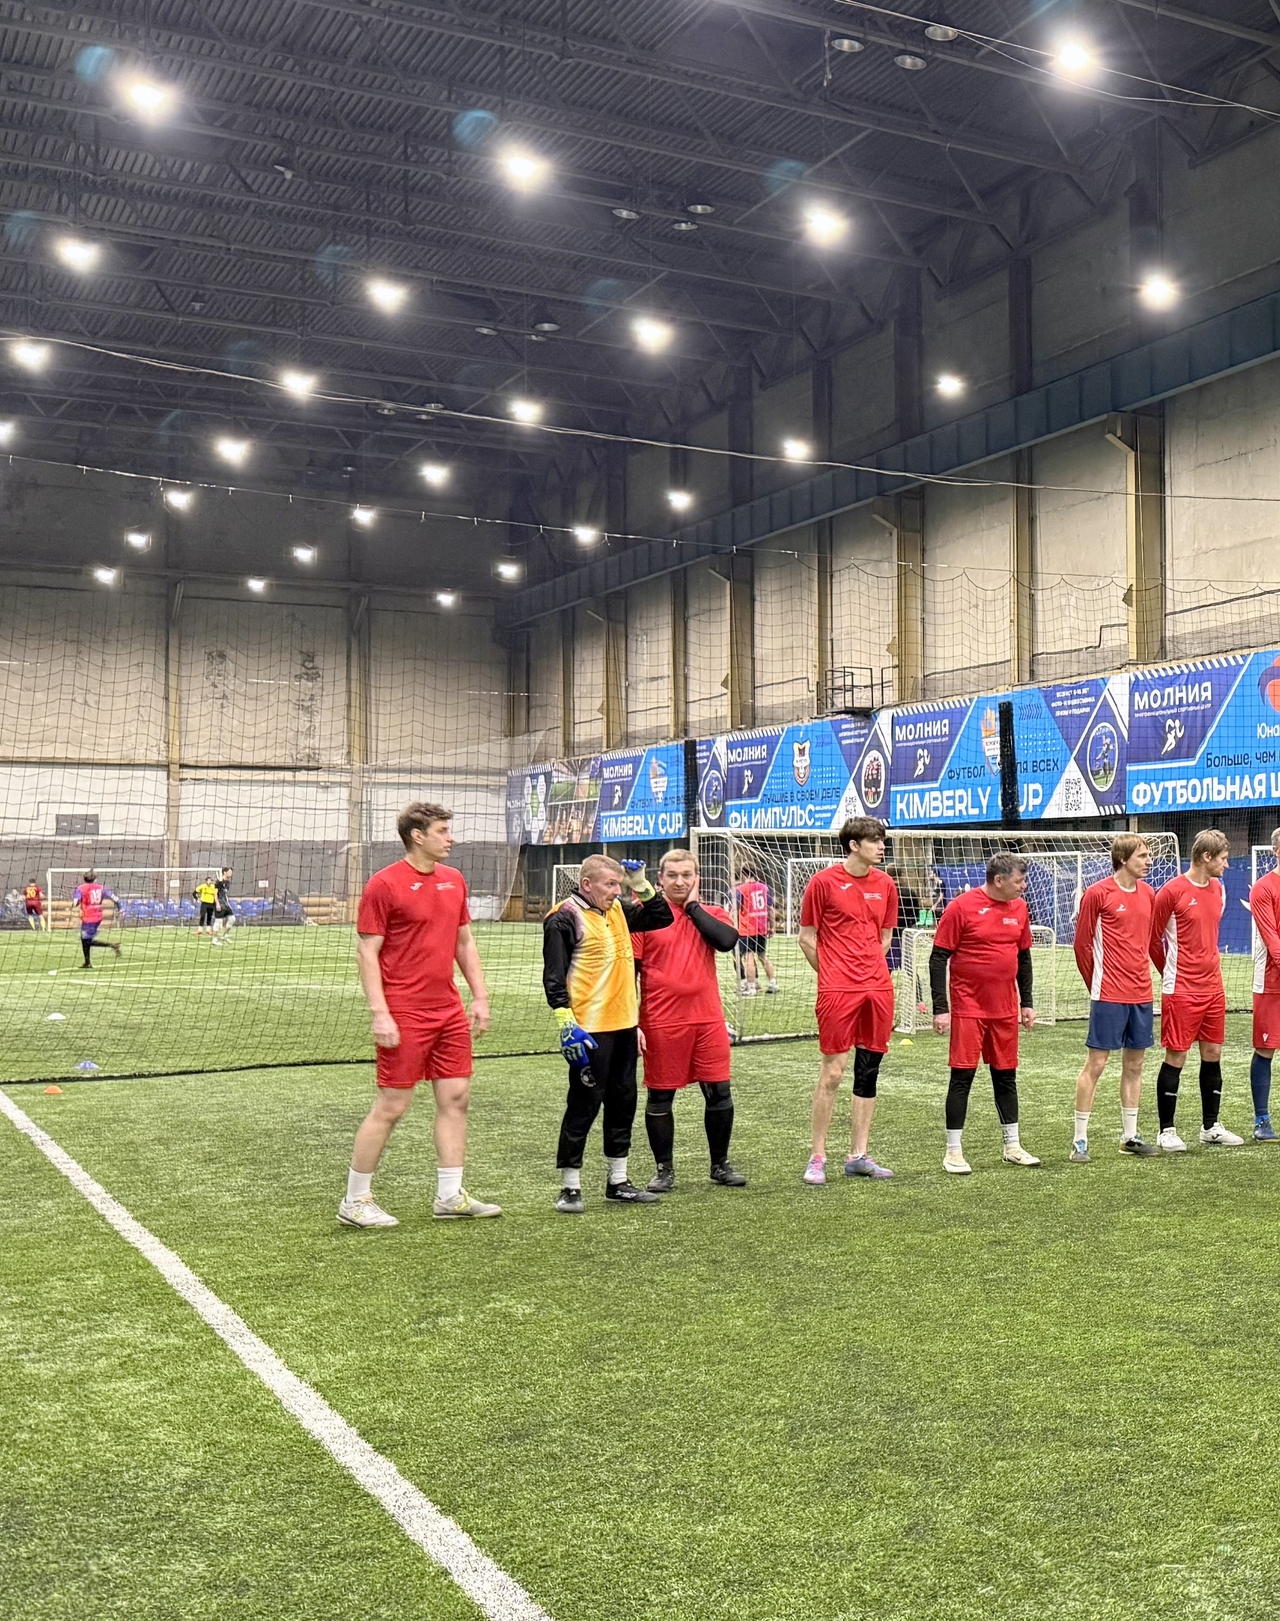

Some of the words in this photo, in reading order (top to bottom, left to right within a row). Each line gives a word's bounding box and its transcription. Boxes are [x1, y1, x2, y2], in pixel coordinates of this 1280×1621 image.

[1134, 681, 1212, 711] МОЛНИЯ
[895, 718, 950, 741] МОЛНИЯ
[727, 744, 767, 763] МОЛНИЯ
[1206, 752, 1252, 768] Больше,
[1255, 751, 1276, 764] чем
[603, 763, 633, 779] МОЛНИЯ
[947, 765, 986, 780] ФУТБОЛ
[1032, 757, 1060, 773] ВСЕХ
[822, 787, 841, 801] ДЕЛЕ
[1131, 773, 1266, 807] ФУТБОЛЬНАЯ
[895, 786, 992, 820] KIMBERLY
[602, 813, 657, 838] KIMBERLY
[658, 811, 683, 835] CUP
[751, 803, 815, 829] ИМПУЛЬС
[751, 890, 765, 910] 15
